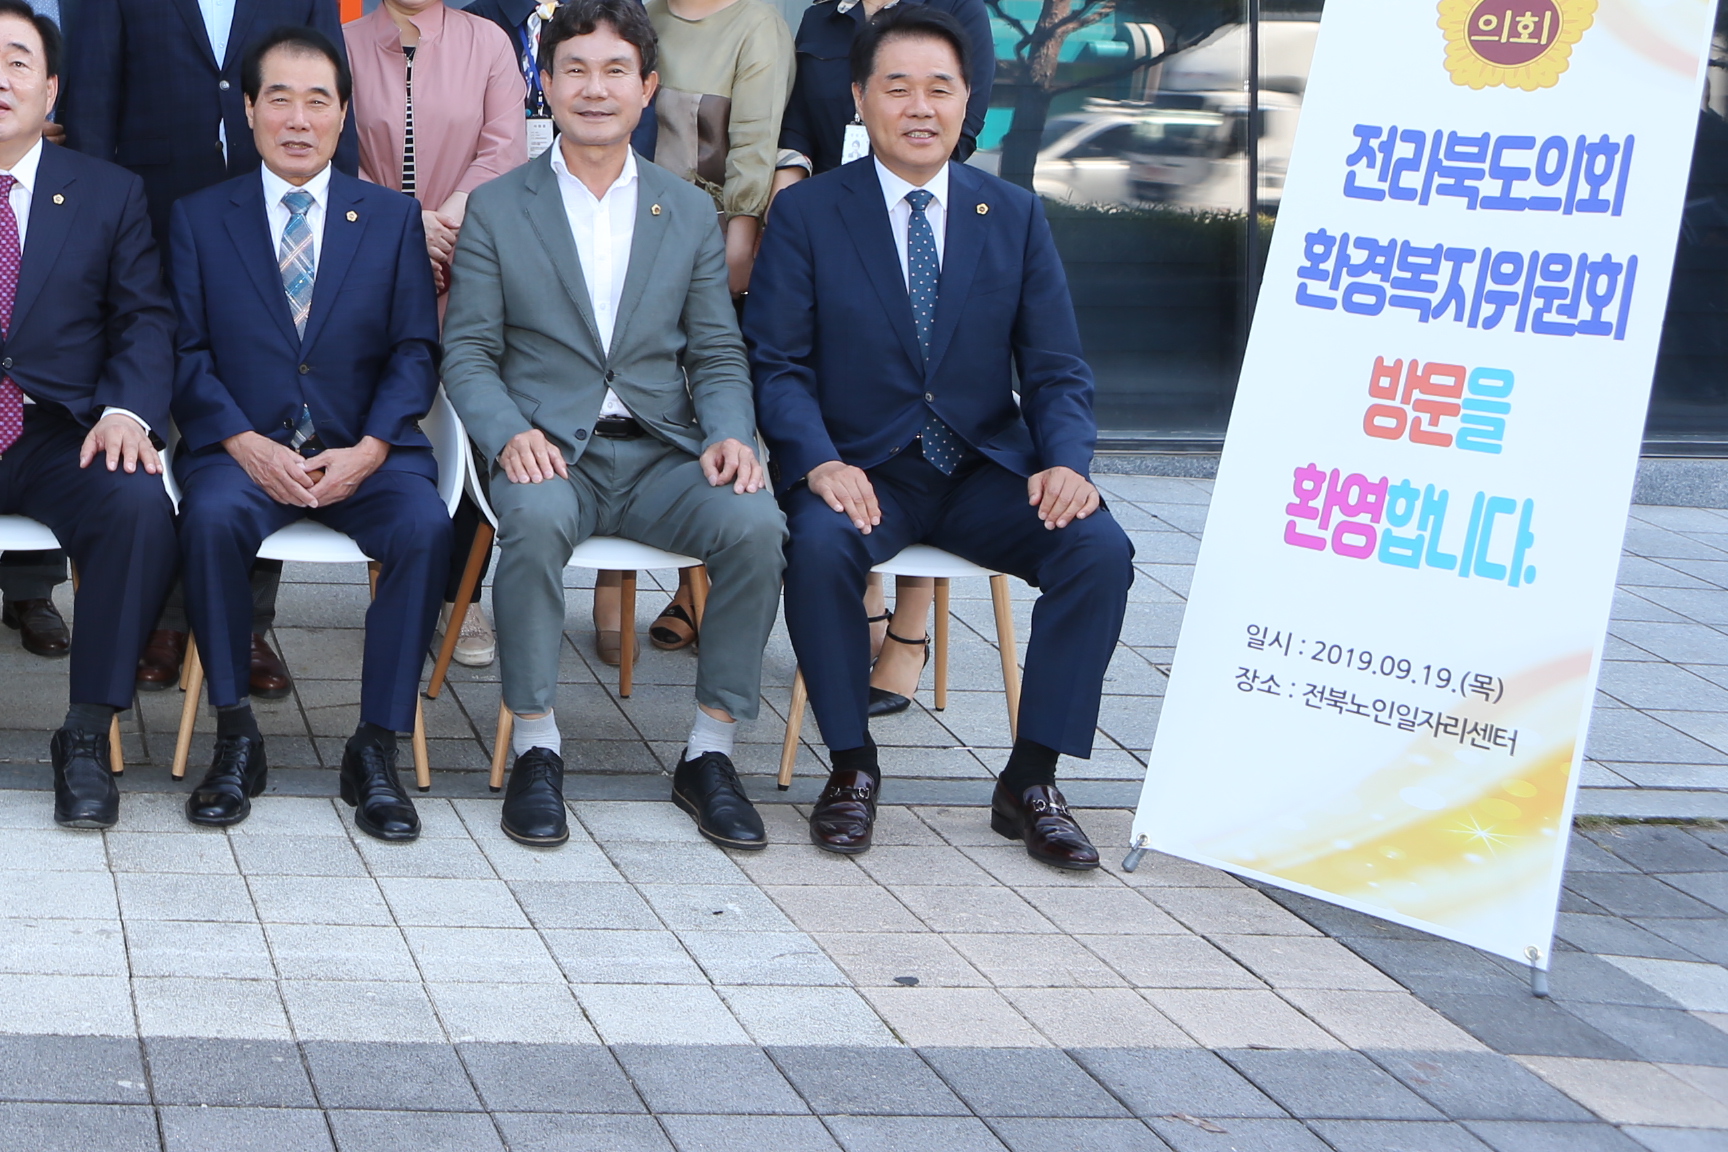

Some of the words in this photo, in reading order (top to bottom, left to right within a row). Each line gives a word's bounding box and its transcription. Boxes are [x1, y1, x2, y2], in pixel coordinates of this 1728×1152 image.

[1470, 9, 1552, 46] 의회
[1342, 123, 1635, 217] 전라북도의회
[1294, 228, 1639, 341] 환경복지위원회
[1362, 355, 1515, 455] 방문을
[1283, 462, 1537, 588] 환영합니다.
[1246, 624, 1293, 657] 일시
[1310, 640, 1505, 705] 2019.09.19.(목)
[1234, 666, 1282, 697] 장소
[1302, 682, 1519, 758] 전북노인일자리센터
